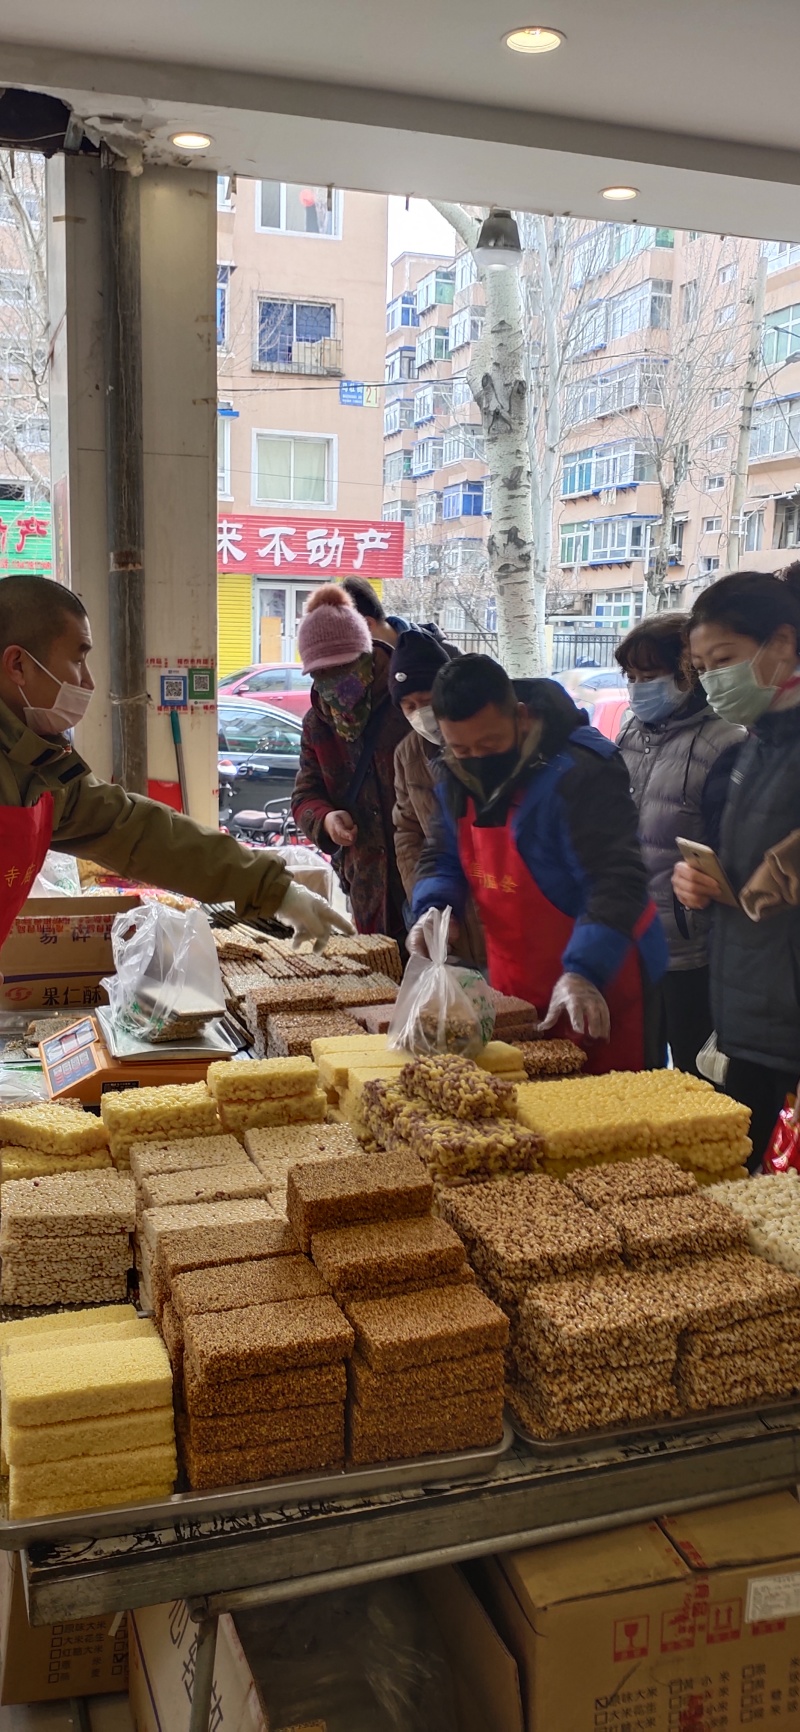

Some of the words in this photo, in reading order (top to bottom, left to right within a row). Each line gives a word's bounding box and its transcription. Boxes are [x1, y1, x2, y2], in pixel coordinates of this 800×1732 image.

[366, 385, 378, 404] 21
[217, 519, 392, 569] 来不动产
[42, 986, 102, 1006] 果仁酥
[62, 1633, 104, 1645] 大米花生
